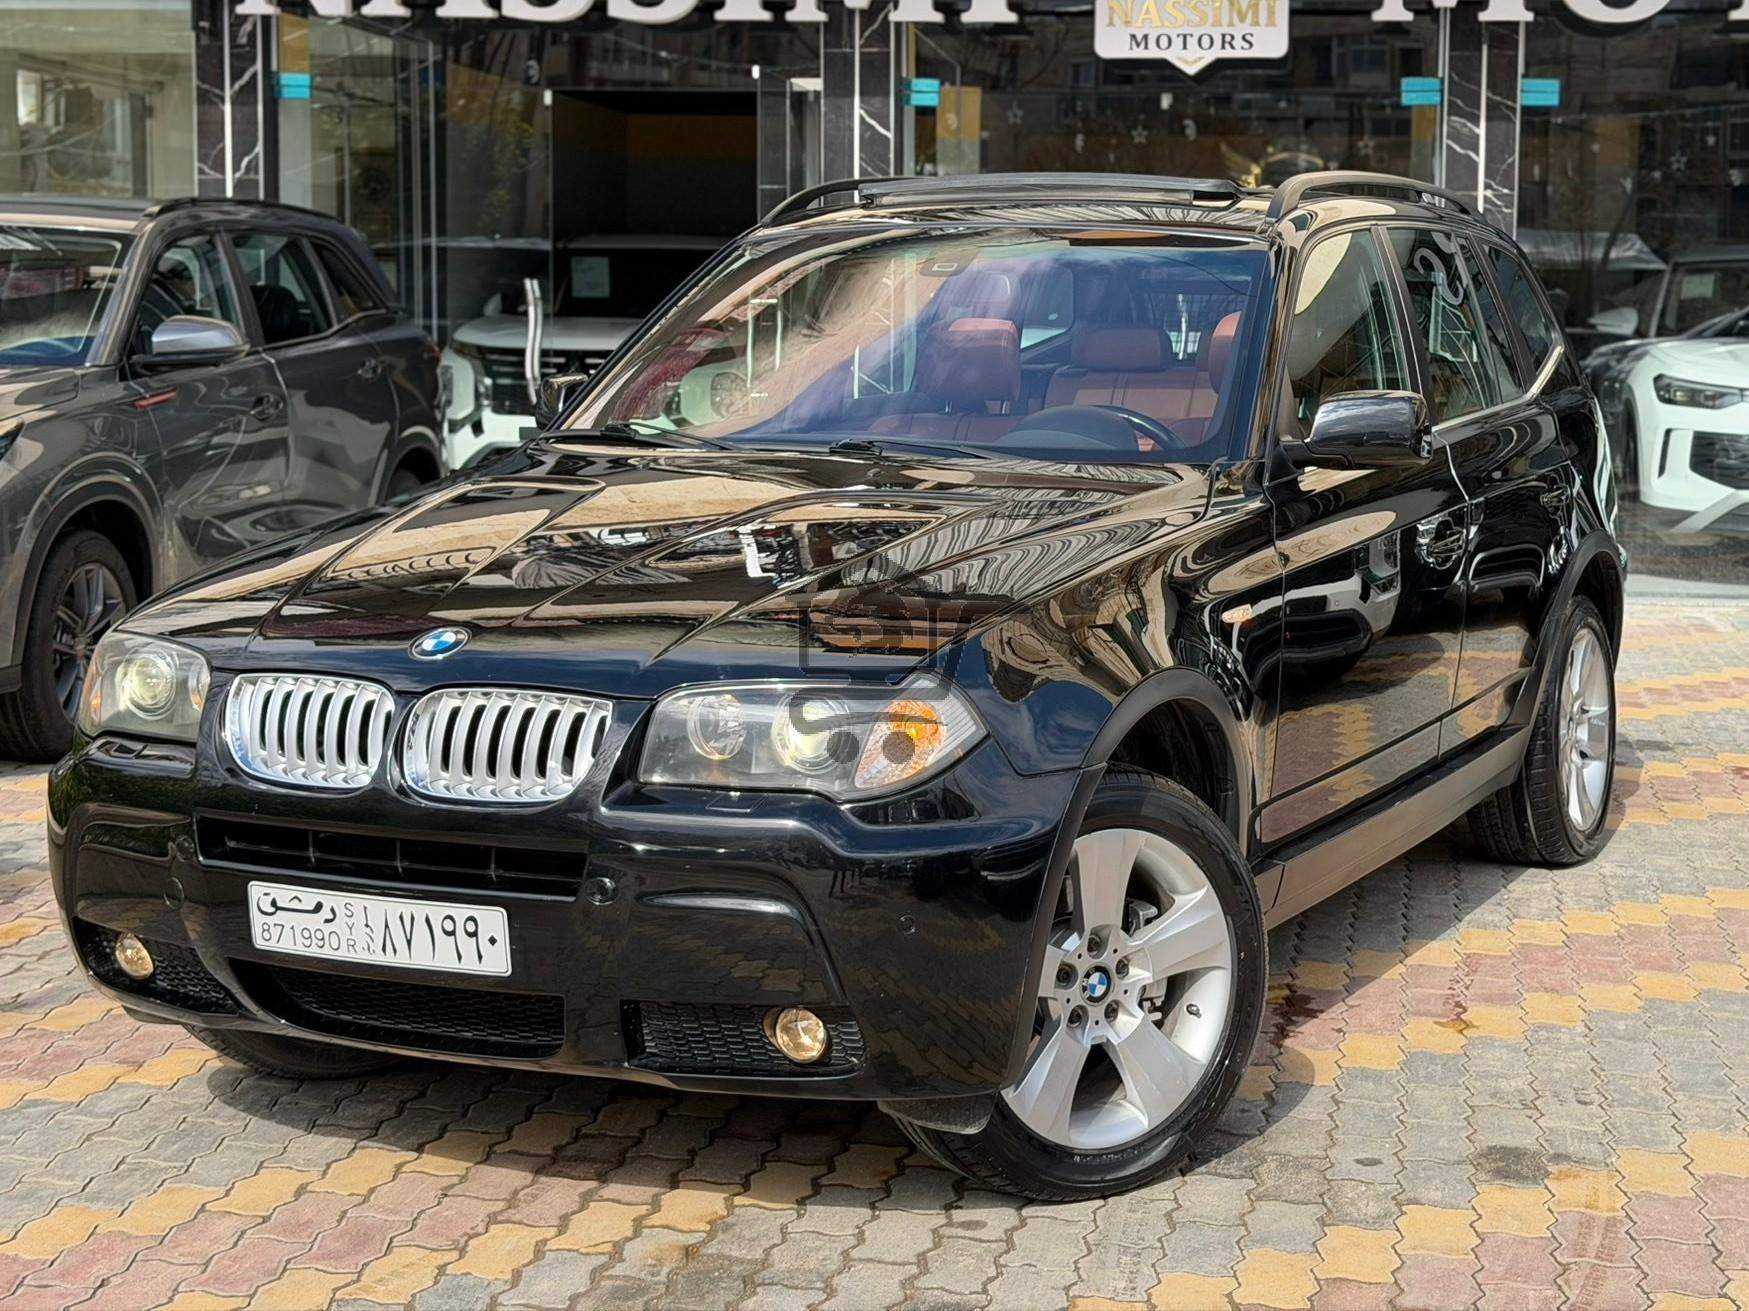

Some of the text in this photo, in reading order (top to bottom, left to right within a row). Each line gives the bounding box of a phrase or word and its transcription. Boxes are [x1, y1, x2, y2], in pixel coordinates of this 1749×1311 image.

[1128, 33, 1254, 51] MOTORS
[257, 892, 337, 924] دمشق
[261, 922, 341, 952] 871990
[381, 908, 498, 965] ٨٧١٩٩٠
